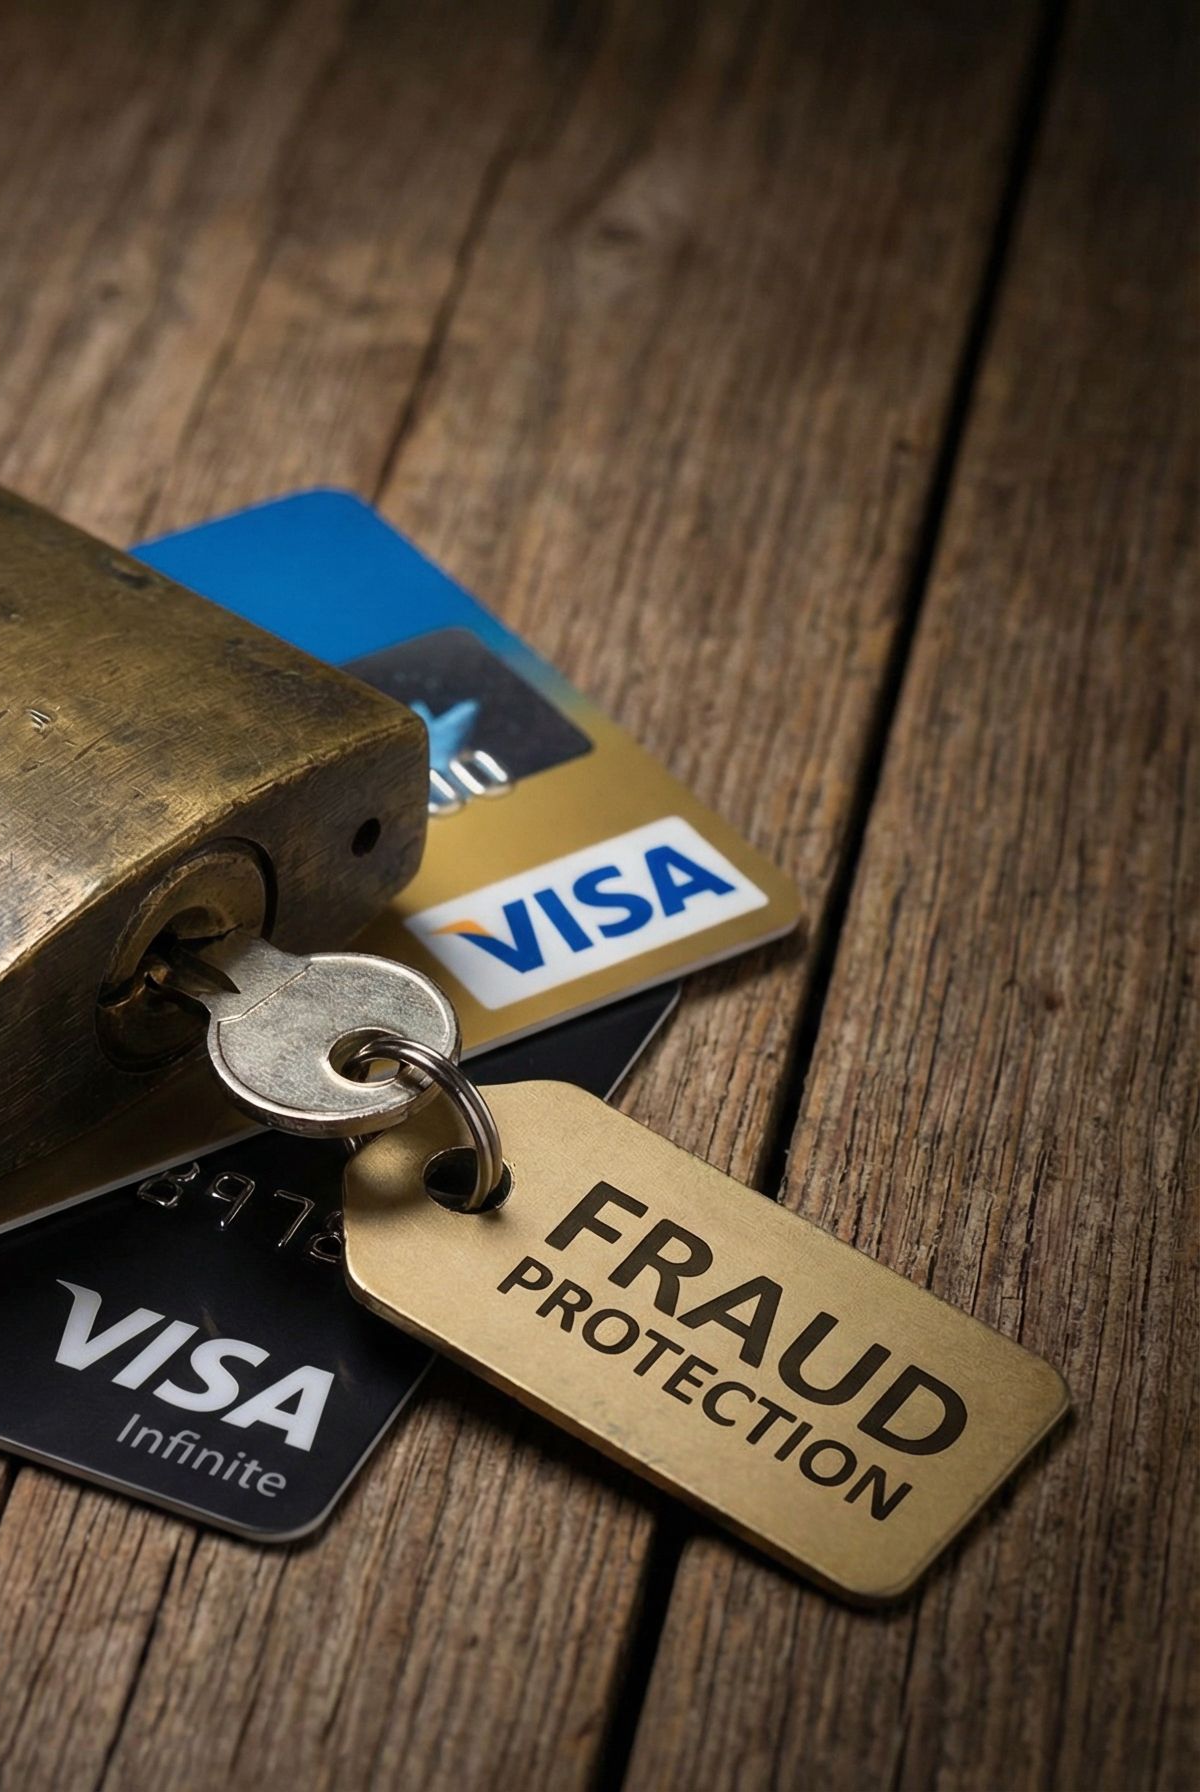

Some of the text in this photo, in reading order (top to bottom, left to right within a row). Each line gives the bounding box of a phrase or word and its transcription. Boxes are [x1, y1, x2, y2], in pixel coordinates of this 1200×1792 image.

[430, 846, 735, 973] VISA
[56, 1279, 335, 1452] VISA
[497, 1256, 913, 1521] PROTECTION
[544, 1181, 968, 1456] FRAUD
[116, 1414, 288, 1497] Infinite
